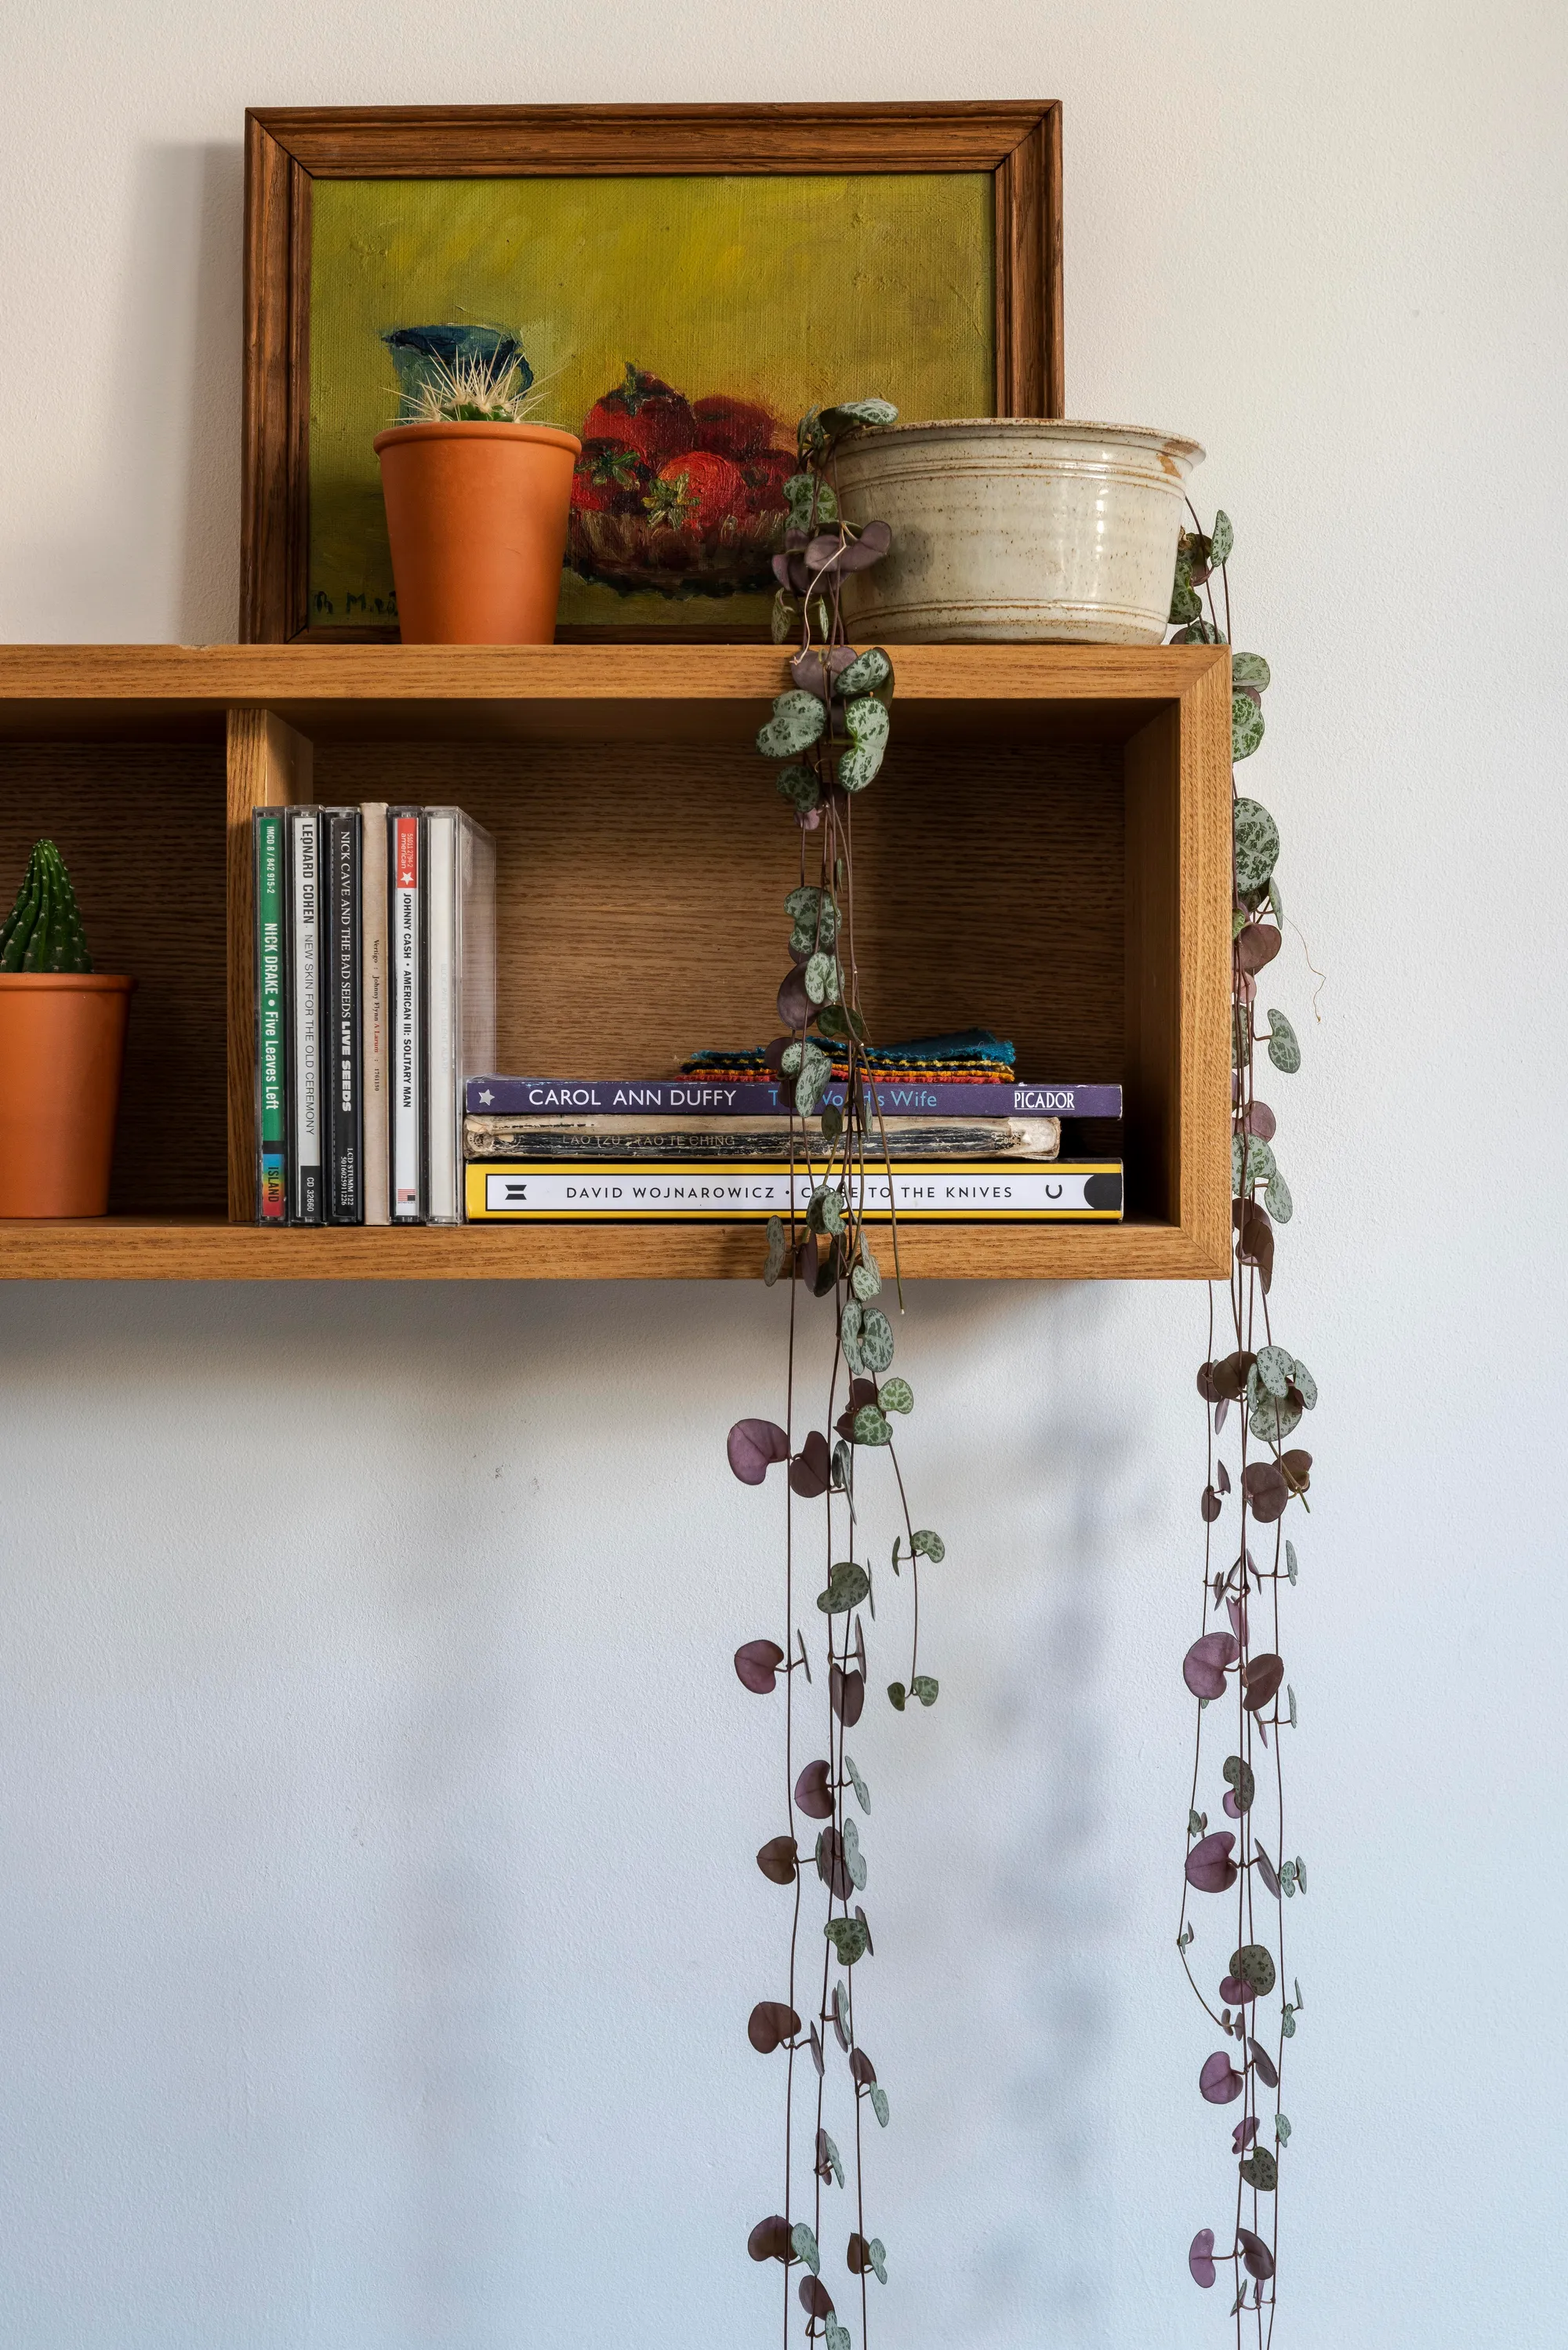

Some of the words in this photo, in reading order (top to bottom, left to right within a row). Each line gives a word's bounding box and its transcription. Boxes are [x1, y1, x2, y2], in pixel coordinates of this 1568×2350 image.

[267, 826, 275, 844] IMCD
[340, 831, 350, 860] NICK
[302, 824, 314, 878] LEONARD
[267, 859, 275, 871] 842
[267, 873, 275, 894] 915-2
[340, 863, 350, 896] CAVE
[303, 884, 314, 924] COHEN
[340, 899, 350, 925] AND
[403, 893, 412, 931] JOHNNY
[264, 923, 278, 952] NICK
[304, 935, 314, 960] NEW
[341, 926, 350, 951] THE
[403, 933, 412, 959] CASH
[264, 956, 278, 994] DRAKE
[304, 964, 314, 990] SKIN
[341, 954, 350, 979] BAD
[372, 975, 380, 999] Johnny
[403, 970, 412, 1020] AMERICAN
[304, 993, 314, 1016] FOR
[341, 982, 351, 1019] SEEDS
[265, 1012, 278, 1036] Five
[305, 1019, 314, 1041] THE
[403, 1023, 412, 1036] III:
[341, 1021, 351, 1055] LIVE
[265, 1041, 279, 1082] Leaves
[305, 1045, 314, 1068] OLD
[403, 1039, 412, 1084] SOLITARY
[266, 1086, 279, 1110] Left
[341, 1060, 351, 1112] SEEDS
[403, 1086, 412, 1107] MAN
[528, 1089, 601, 1106] CAROL
[613, 1089, 662, 1106] ANN
[671, 1089, 737, 1106] DUFFY
[891, 1091, 937, 1106] Wife
[305, 1072, 314, 1135] CEREMONY
[1014, 1092, 1075, 1108] PICADOR
[562, 1135, 590, 1145] LAO
[689, 1135, 735, 1146] CHING
[267, 1167, 279, 1202] ISLAND
[307, 1177, 314, 1187] CD
[566, 1187, 623, 1198] DAVID
[632, 1186, 775, 1198] WOJNAROWICZ
[868, 1187, 891, 1198] TO
[901, 1187, 935, 1198] THE
[946, 1186, 1012, 1198] KNIVES
